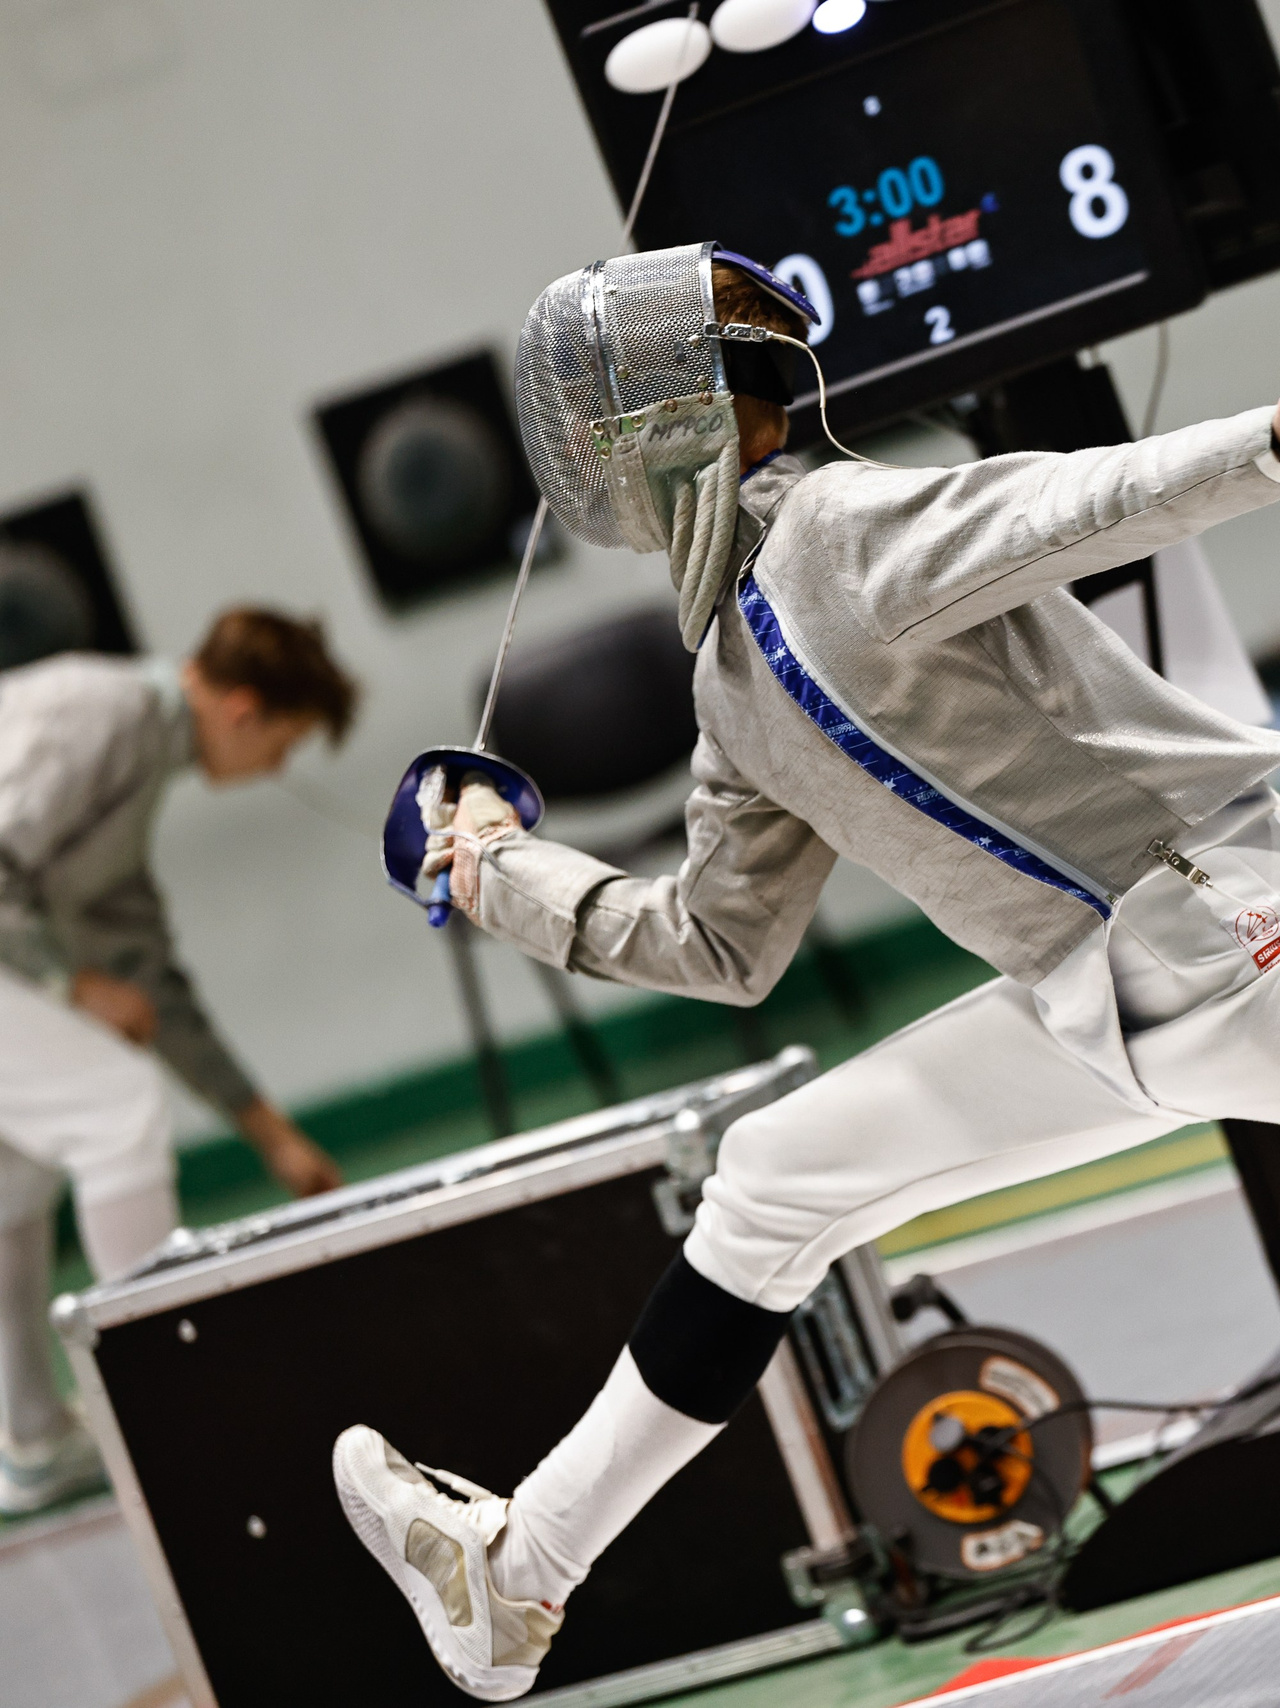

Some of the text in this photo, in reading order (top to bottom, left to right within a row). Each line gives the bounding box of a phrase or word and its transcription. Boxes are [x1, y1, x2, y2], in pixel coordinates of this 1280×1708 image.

[828, 156, 945, 237] 3:00
[1059, 143, 1129, 239] 8
[924, 305, 956, 344] 2
